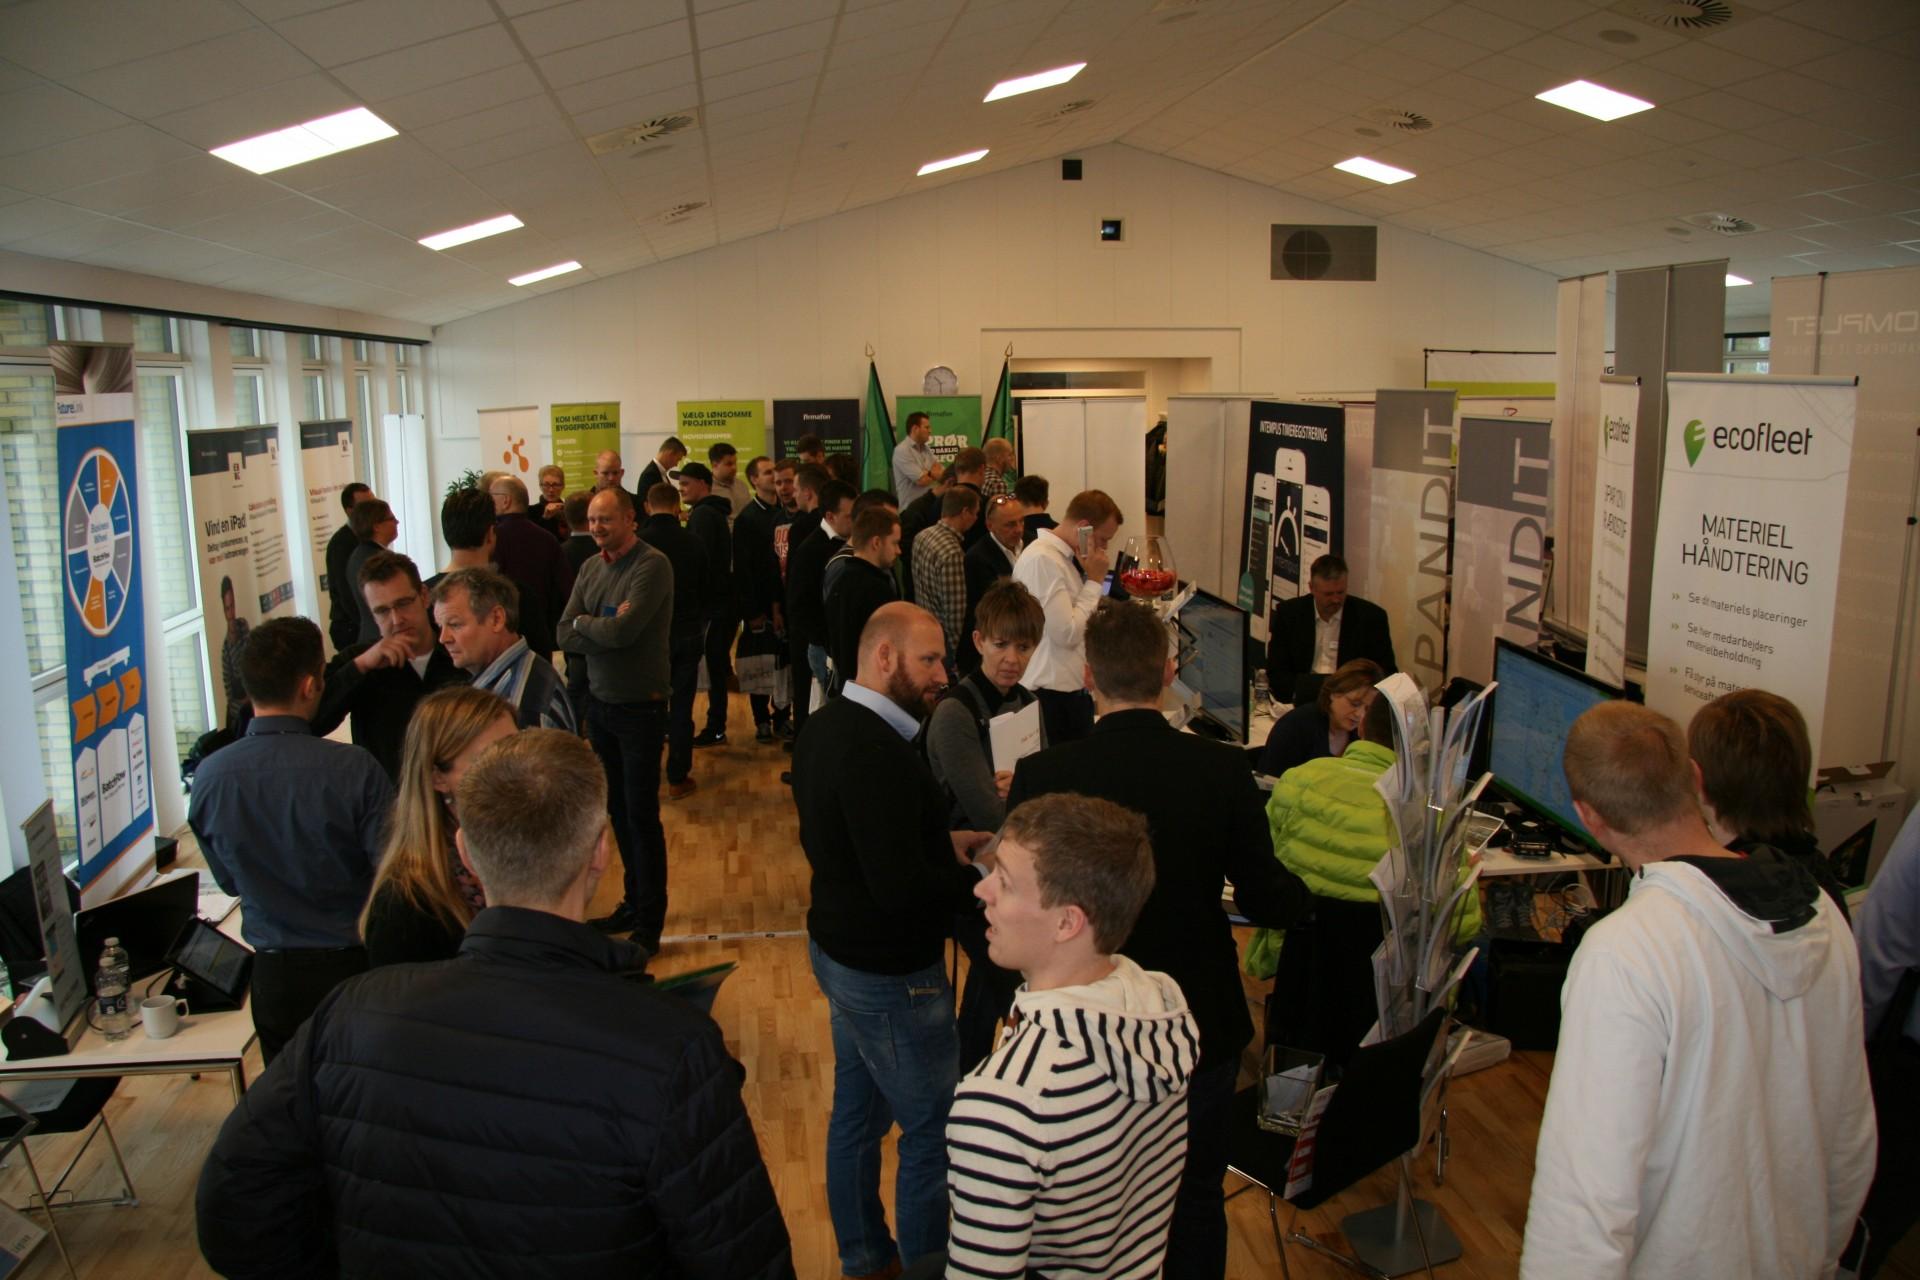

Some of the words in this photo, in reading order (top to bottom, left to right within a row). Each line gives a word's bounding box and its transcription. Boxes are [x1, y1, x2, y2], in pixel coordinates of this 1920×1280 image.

[683, 411, 705, 419] VÆLG
[929, 434, 968, 448] PRØR
[1713, 422, 1813, 455] ecofleet
[1505, 436, 1550, 650] NDIT
[1702, 513, 1793, 549] MATERIEL
[1682, 537, 1809, 585] HÅNDTERING
[1688, 592, 1700, 603] Se
[1711, 597, 1751, 616] materiels
[1752, 607, 1808, 628] placeringer
[1687, 622, 1698, 634] Se
[1713, 631, 1774, 655] medarbejders
[1705, 675, 1716, 690] på
